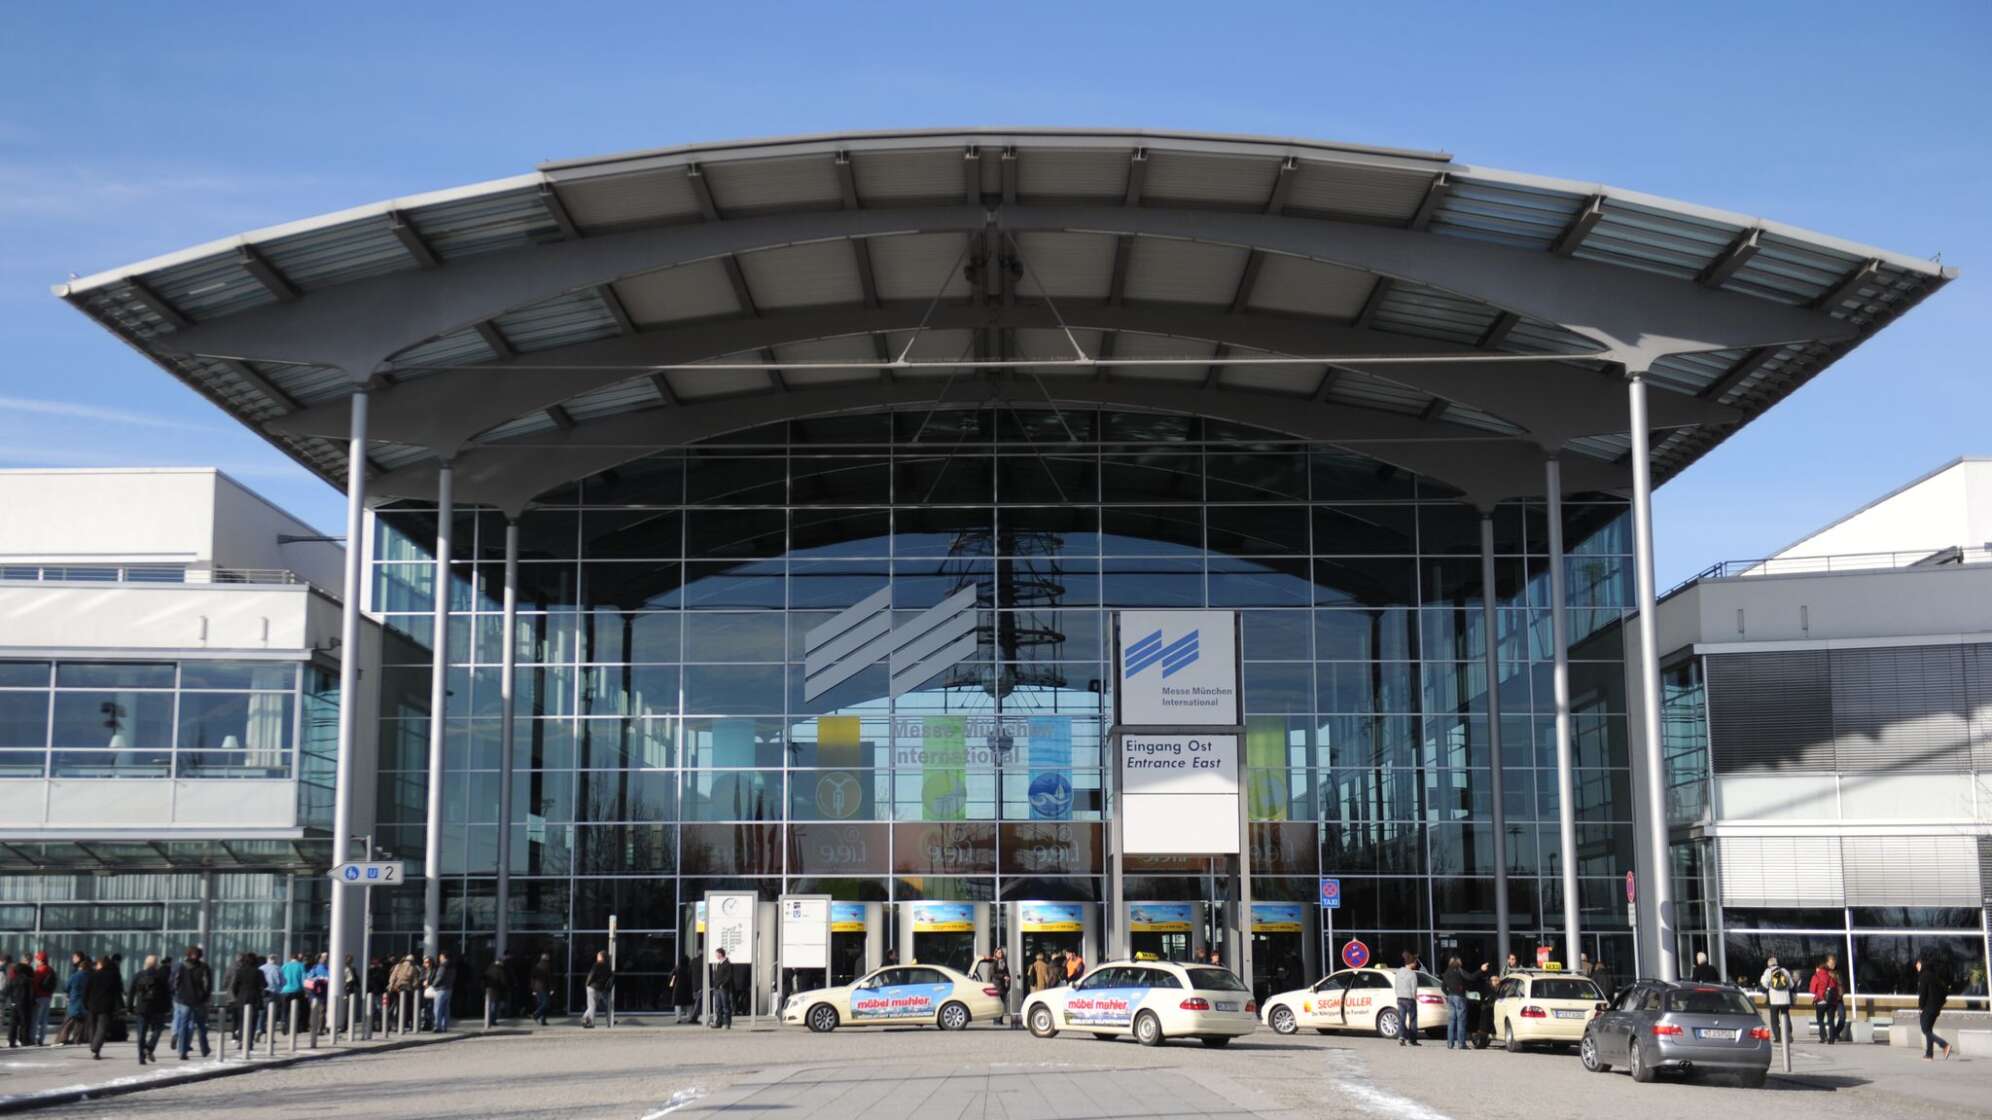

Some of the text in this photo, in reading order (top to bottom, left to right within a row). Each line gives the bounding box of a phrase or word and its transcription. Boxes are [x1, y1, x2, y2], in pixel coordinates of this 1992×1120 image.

[1162, 686, 1233, 696] Messe München
[1162, 698, 1219, 707] International
[1126, 739, 1213, 755] Eingang Ost
[1127, 757, 1222, 769] Entrance East
[385, 865, 394, 880] 2
[1323, 898, 1338, 906] TAXI
[857, 998, 889, 1009] möbel
[1068, 998, 1094, 1009] möbel
